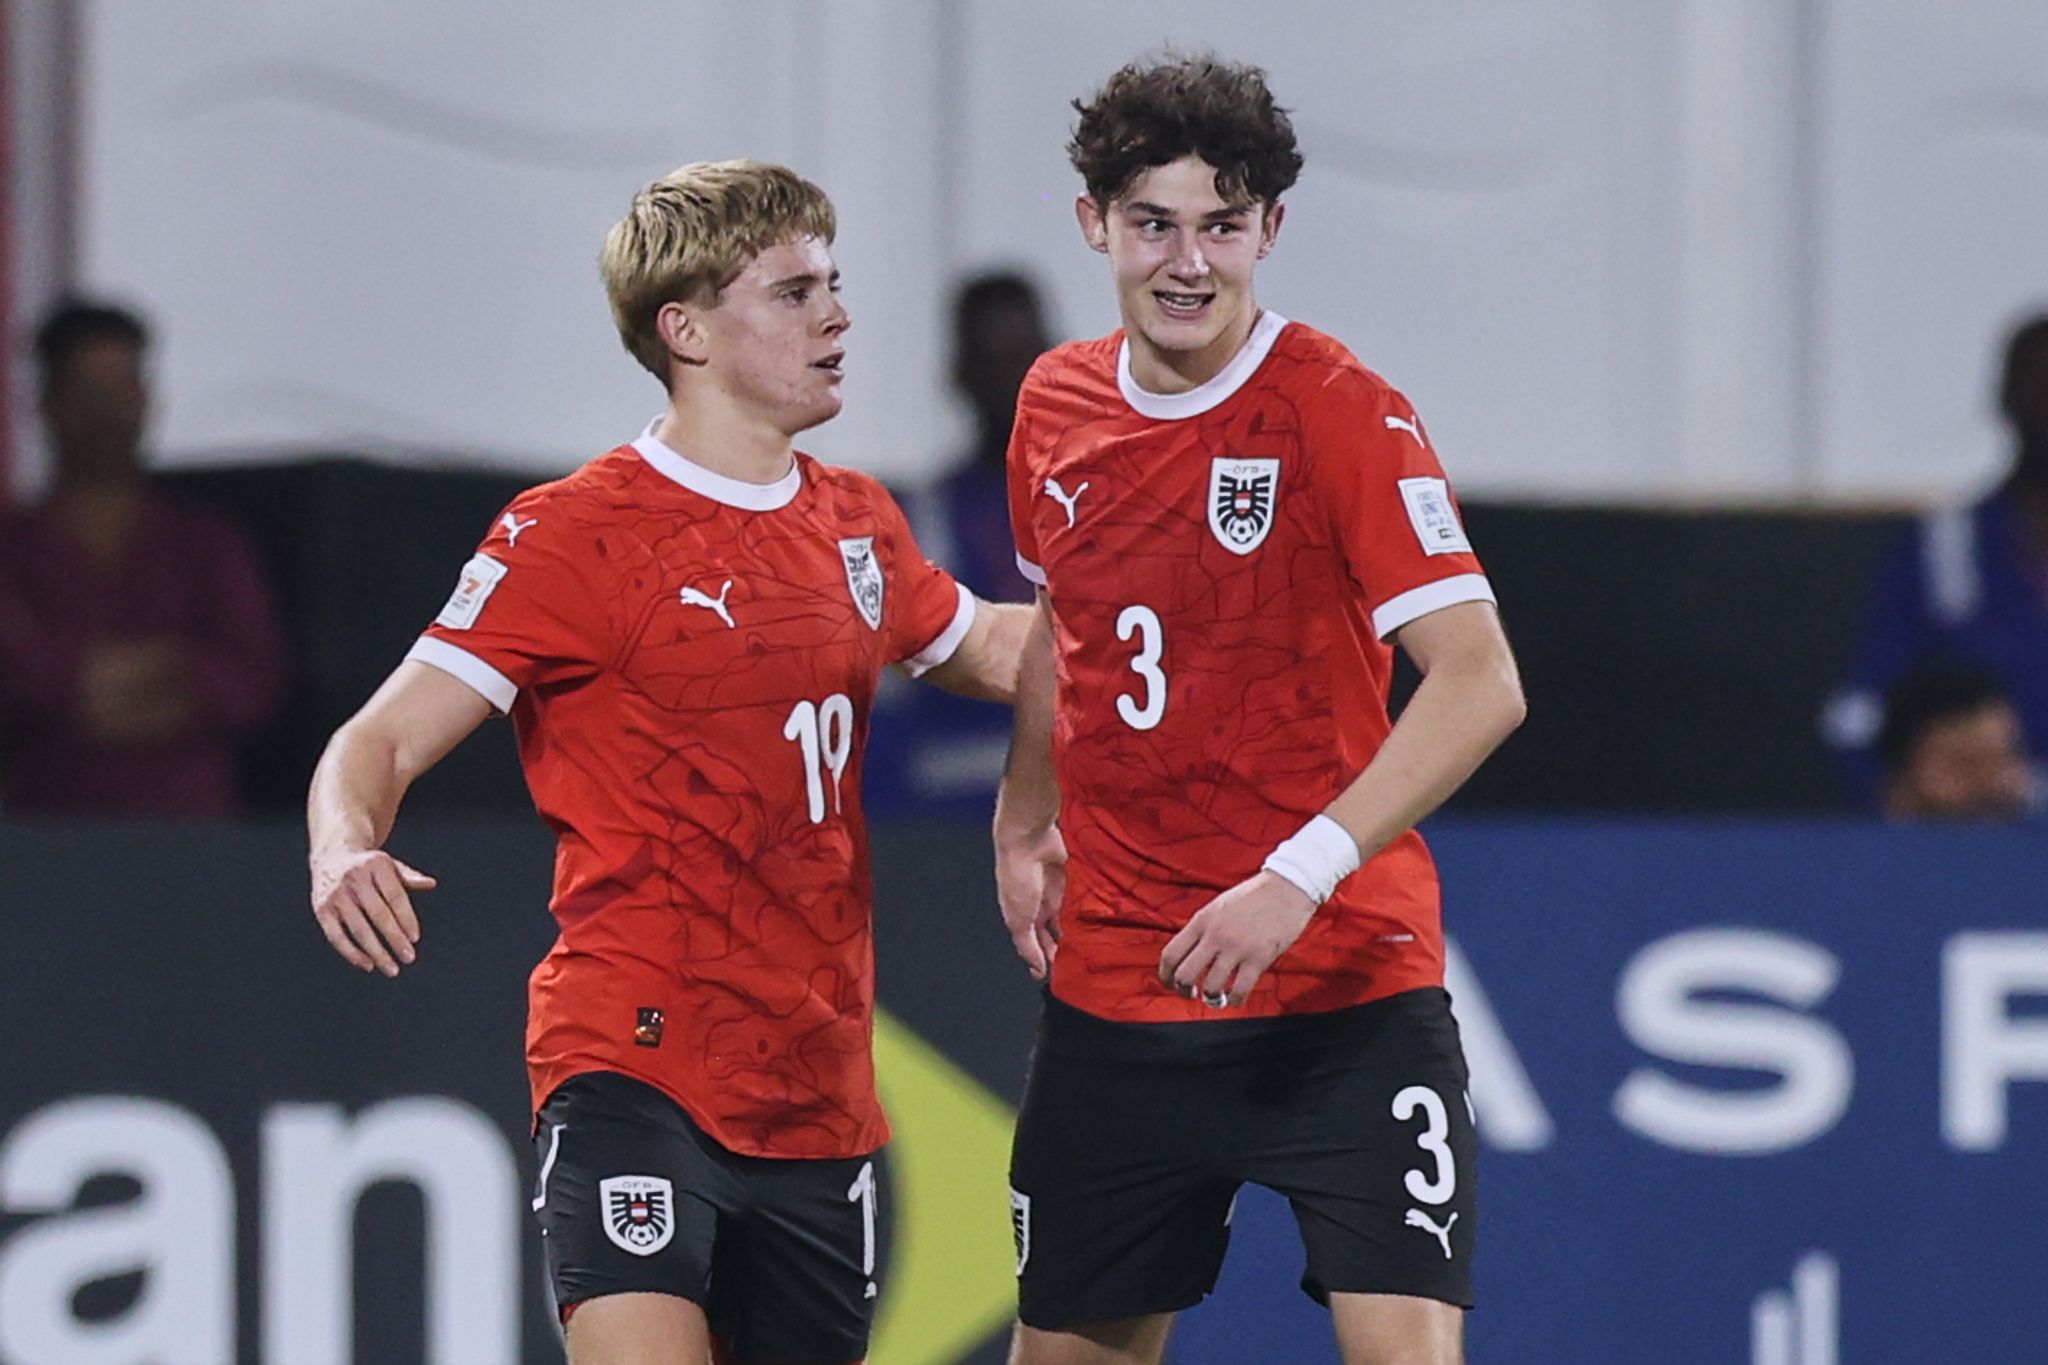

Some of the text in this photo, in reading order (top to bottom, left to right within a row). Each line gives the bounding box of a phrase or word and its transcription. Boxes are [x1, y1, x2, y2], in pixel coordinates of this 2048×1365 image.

[1116, 605, 1167, 730] 3
[783, 694, 854, 824] 19
[1391, 1085, 1456, 1205] 3
[847, 1161, 878, 1277] 1
